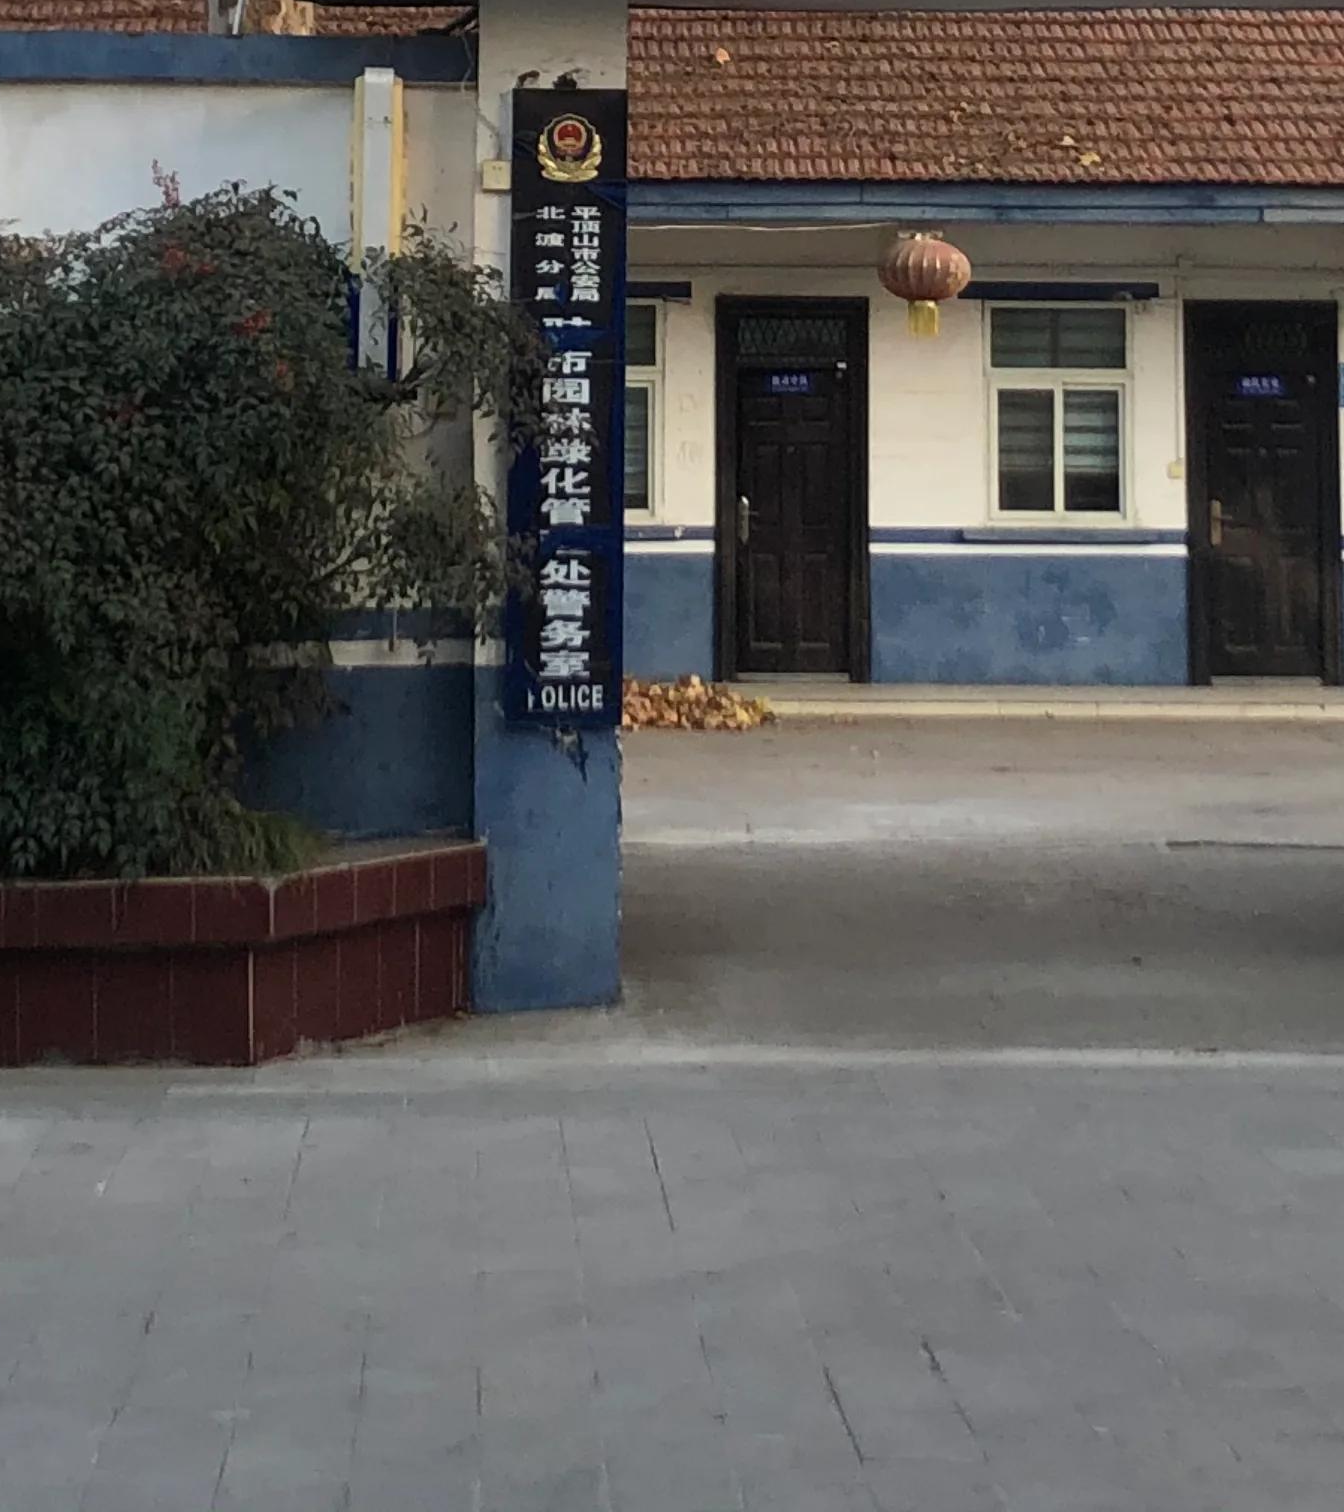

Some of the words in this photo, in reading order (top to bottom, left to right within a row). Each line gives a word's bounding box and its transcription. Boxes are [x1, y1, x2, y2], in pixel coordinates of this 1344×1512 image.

[570, 205, 601, 302] 平顶山市公安局
[540, 316, 592, 677] 市园林绿化管处警务室
